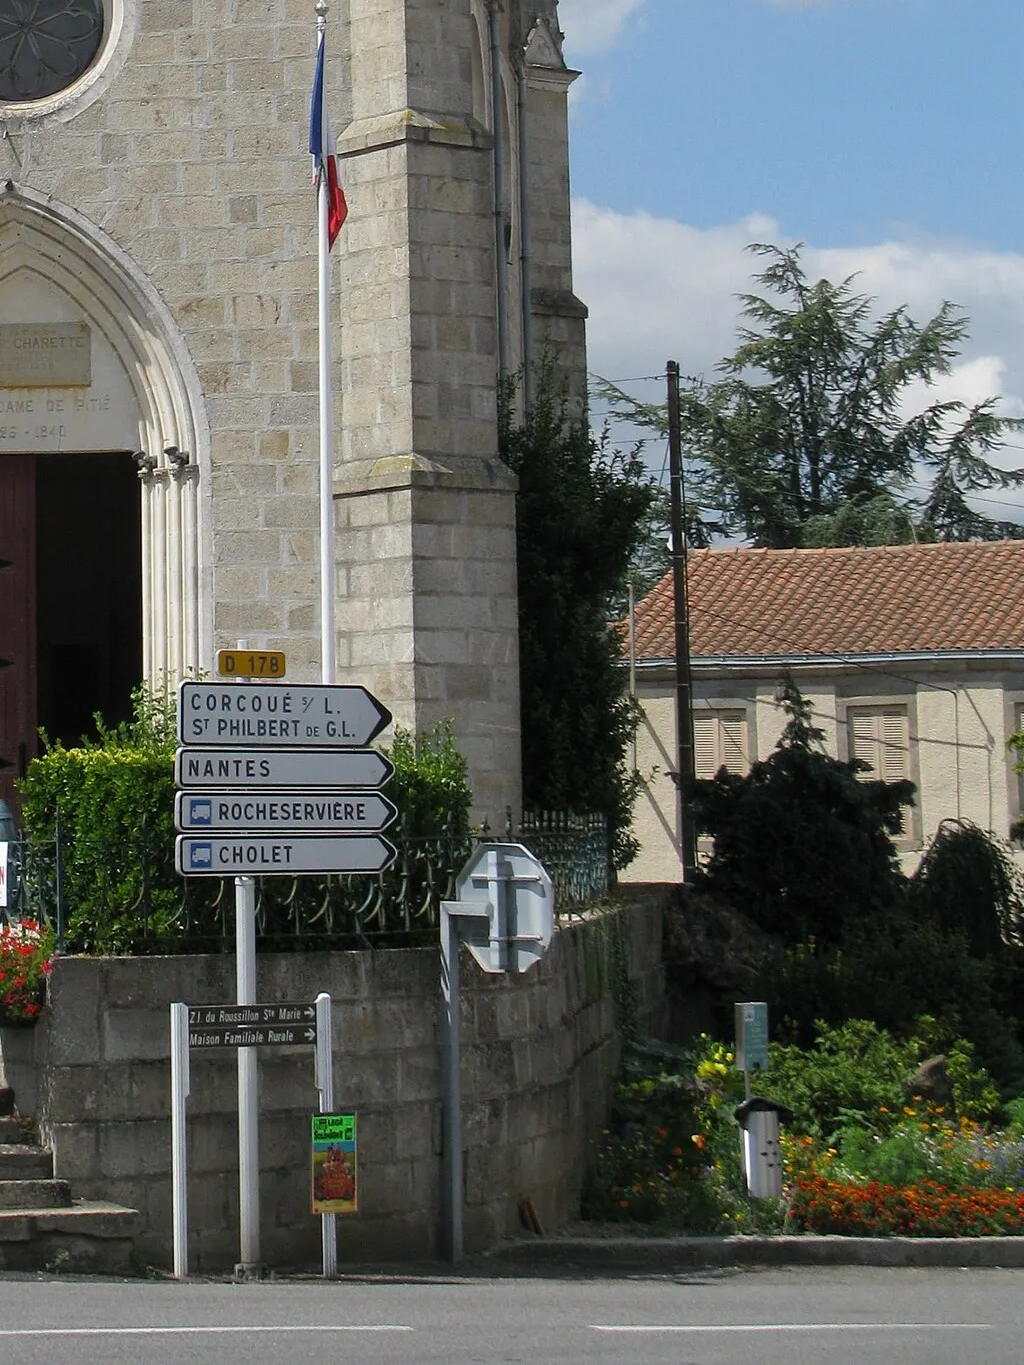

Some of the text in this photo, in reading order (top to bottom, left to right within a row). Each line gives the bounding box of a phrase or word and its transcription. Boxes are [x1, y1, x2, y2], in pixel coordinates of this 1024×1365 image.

[14, 336, 85, 349] CHARETTE
[46, 399, 64, 412] DE
[226, 655, 280, 674] D 178
[191, 693, 292, 714] CORCOUÉ
[324, 697, 340, 714] L.
[217, 719, 300, 737] PHILBERT
[306, 726, 319, 737] DE
[326, 720, 356, 738] G.L.
[188, 759, 270, 778] NANTES
[219, 845, 293, 864] CHOLET
[205, 1011, 215, 1023] du
[219, 1009, 259, 1023] Roussillon
[278, 1007, 301, 1021] Marie
[189, 1030, 293, 1046] Maison Familiale Rurale
